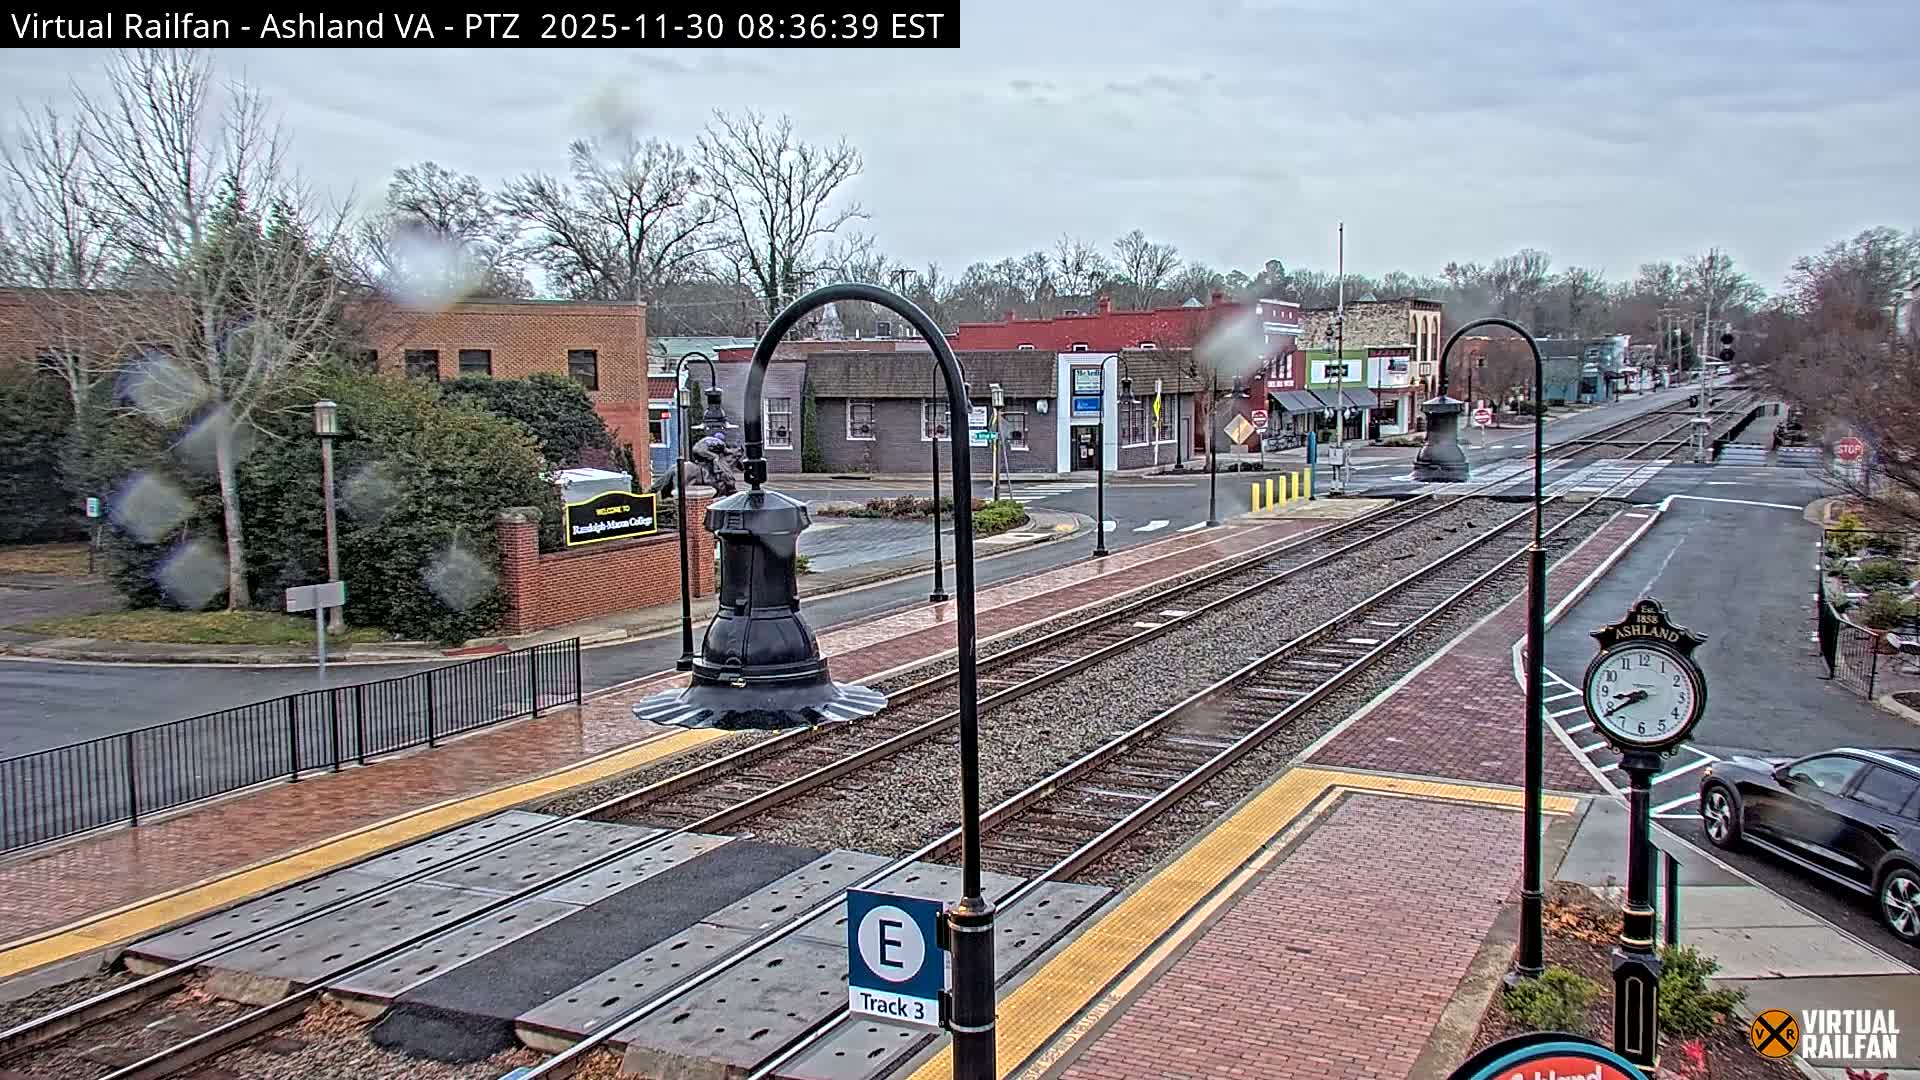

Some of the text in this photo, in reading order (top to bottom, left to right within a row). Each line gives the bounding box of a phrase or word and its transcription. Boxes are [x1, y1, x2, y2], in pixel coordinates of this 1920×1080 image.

[1837, 443, 1862, 455] STOP
[629, 516, 653, 527] College
[1615, 624, 1680, 642] ASHLAND
[1621, 657, 1631, 670] 11
[1639, 654, 1651, 667] 12
[1605, 670, 1618, 682] 10
[1672, 674, 1681, 688] 2
[1601, 685, 1609, 698] 9
[1670, 706, 1680, 720] 4
[1618, 715, 1626, 729] 7
[1637, 721, 1646, 735] 6
[1657, 719, 1667, 732] 5
[879, 919, 904, 969] E
[860, 992, 925, 1020] Track 3
